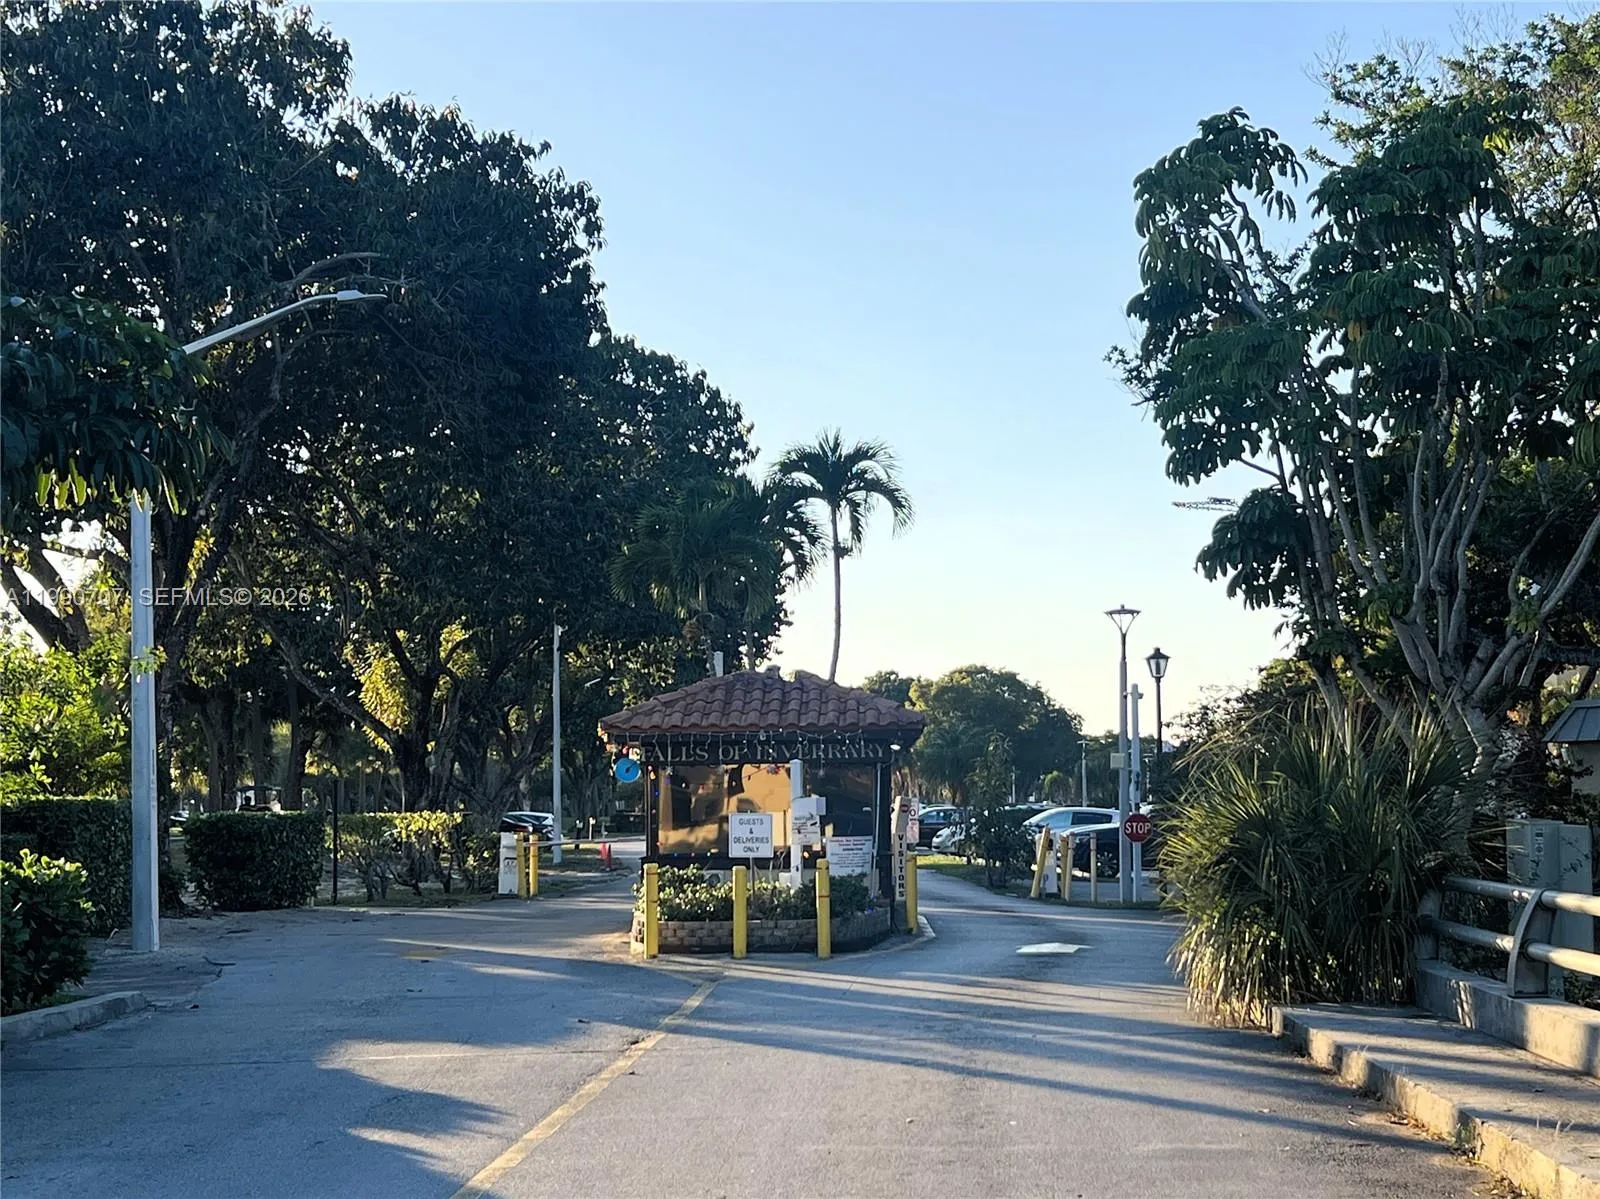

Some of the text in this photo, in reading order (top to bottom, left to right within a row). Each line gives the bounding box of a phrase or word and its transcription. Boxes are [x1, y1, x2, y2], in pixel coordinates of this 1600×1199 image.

[639, 743, 709, 762] FALLS
[756, 742, 886, 760] INVERRARY
[738, 817, 764, 826] GUESTS
[1125, 821, 1151, 834] STOP
[733, 836, 770, 844] DELIVERIES
[742, 845, 760, 853] ONLY
[897, 833, 905, 898] VISITORS
